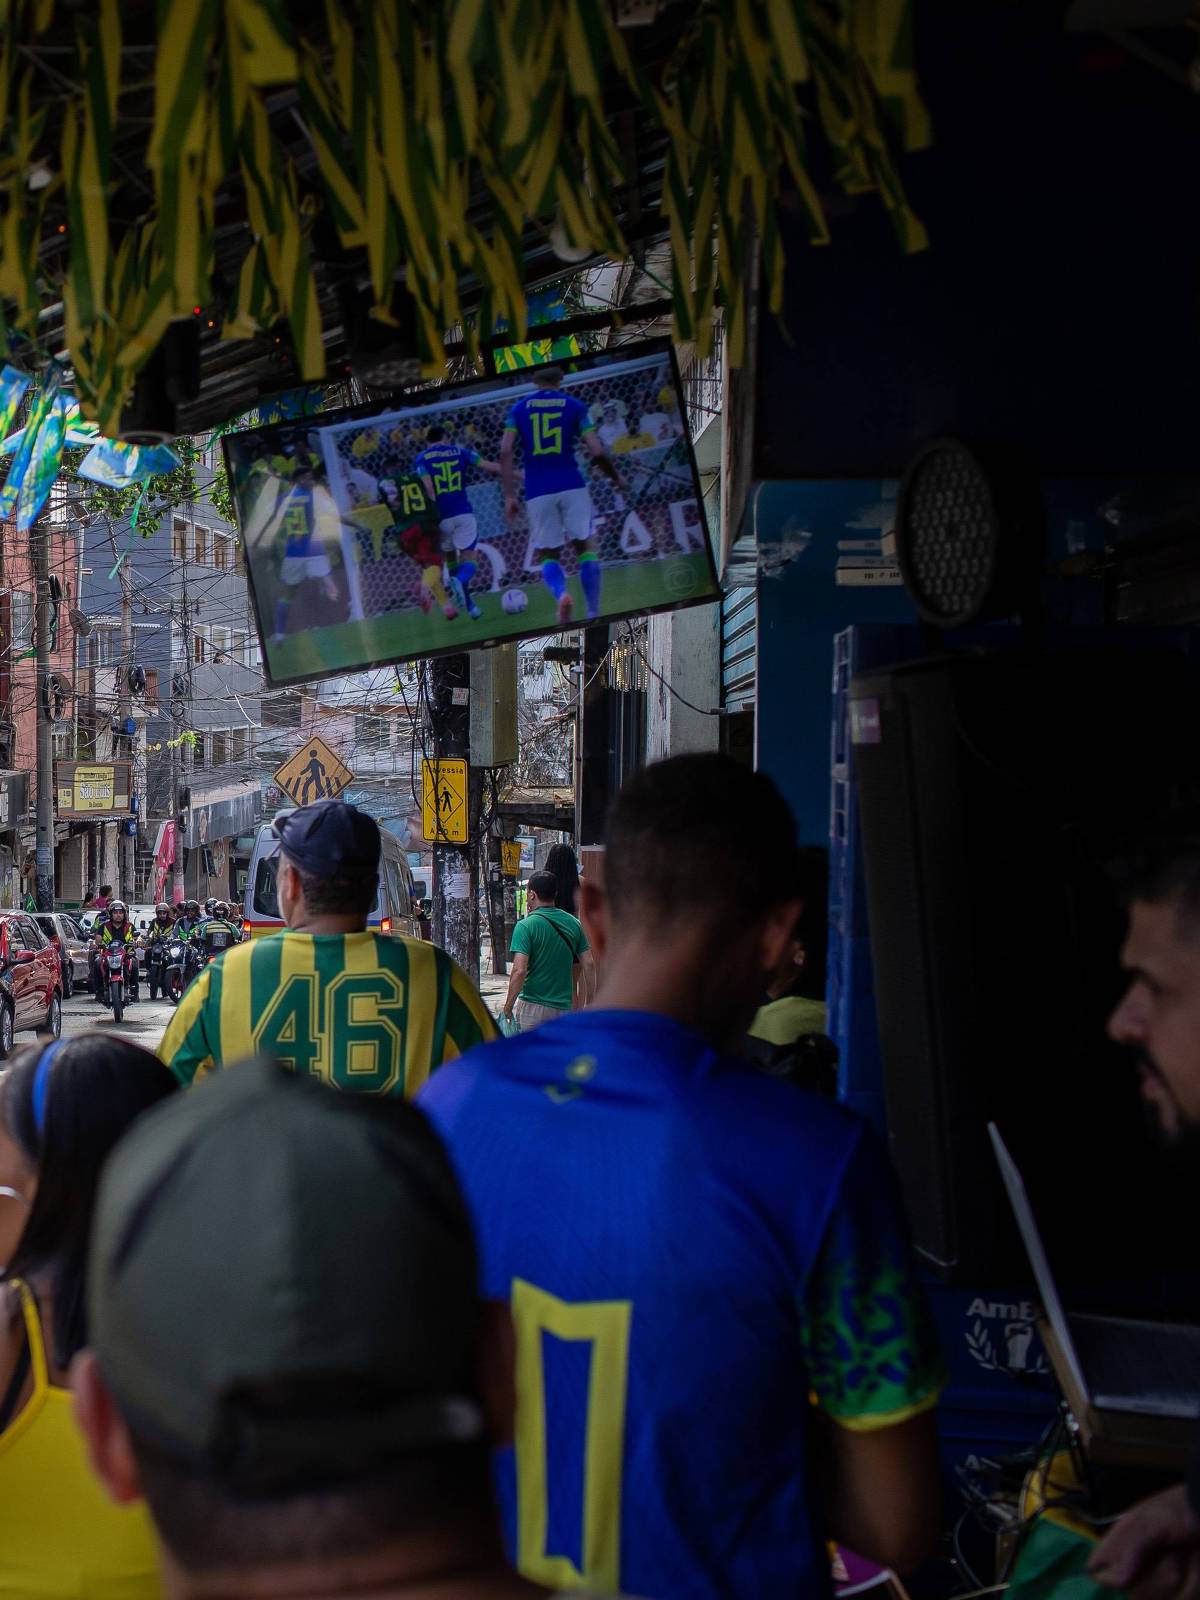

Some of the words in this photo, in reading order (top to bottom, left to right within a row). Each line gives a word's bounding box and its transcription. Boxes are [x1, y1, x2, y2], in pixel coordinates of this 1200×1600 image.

[530, 412, 562, 456] 15
[432, 459, 462, 495] 26
[401, 483, 426, 515] 19
[252, 968, 404, 1094] 46
